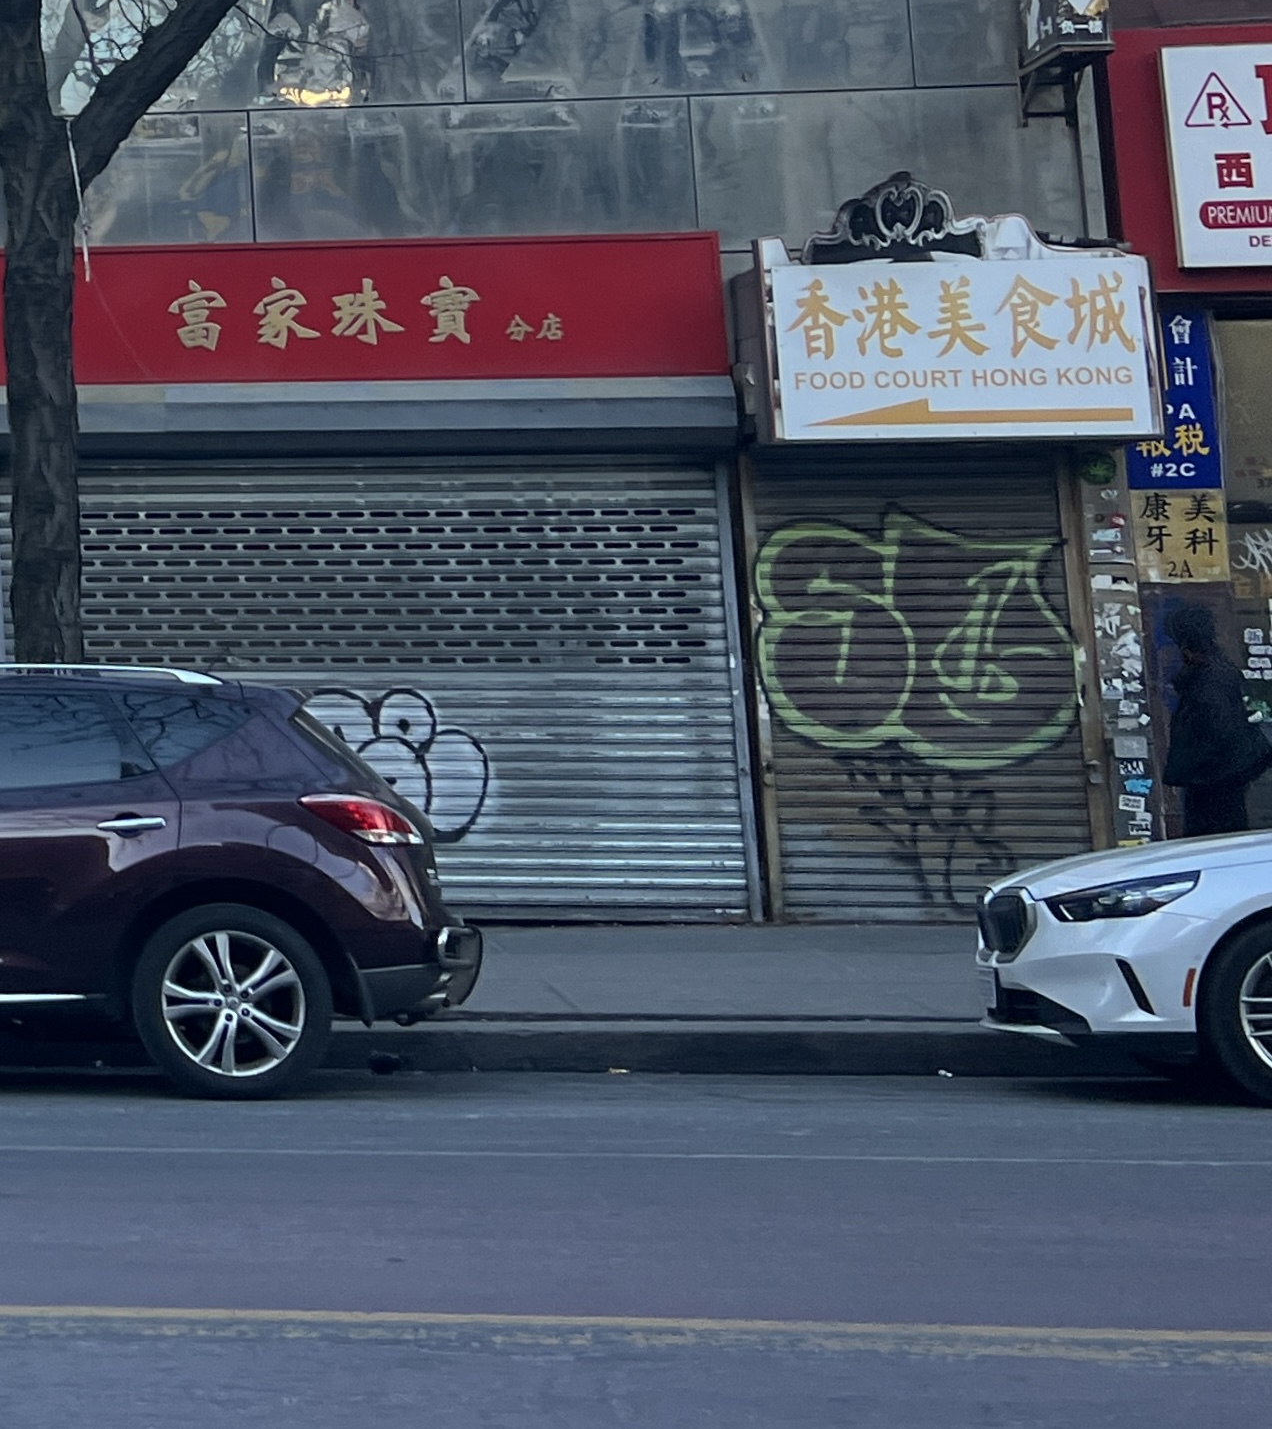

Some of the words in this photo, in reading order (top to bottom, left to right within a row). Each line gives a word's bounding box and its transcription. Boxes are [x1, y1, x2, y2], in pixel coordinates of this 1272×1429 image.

[1214, 153, 1254, 189] 西
[167, 275, 481, 352] 富家珠寶
[504, 312, 565, 342] 分店
[785, 269, 1138, 360] 香港美食城
[1168, 315, 1198, 386] 會計
[794, 371, 866, 391] FOOD
[874, 369, 963, 389] COURT
[971, 367, 1049, 388] HONG
[1057, 366, 1134, 386] KONG
[1150, 463, 1197, 477] #2C
[1167, 560, 1195, 578] 2A
